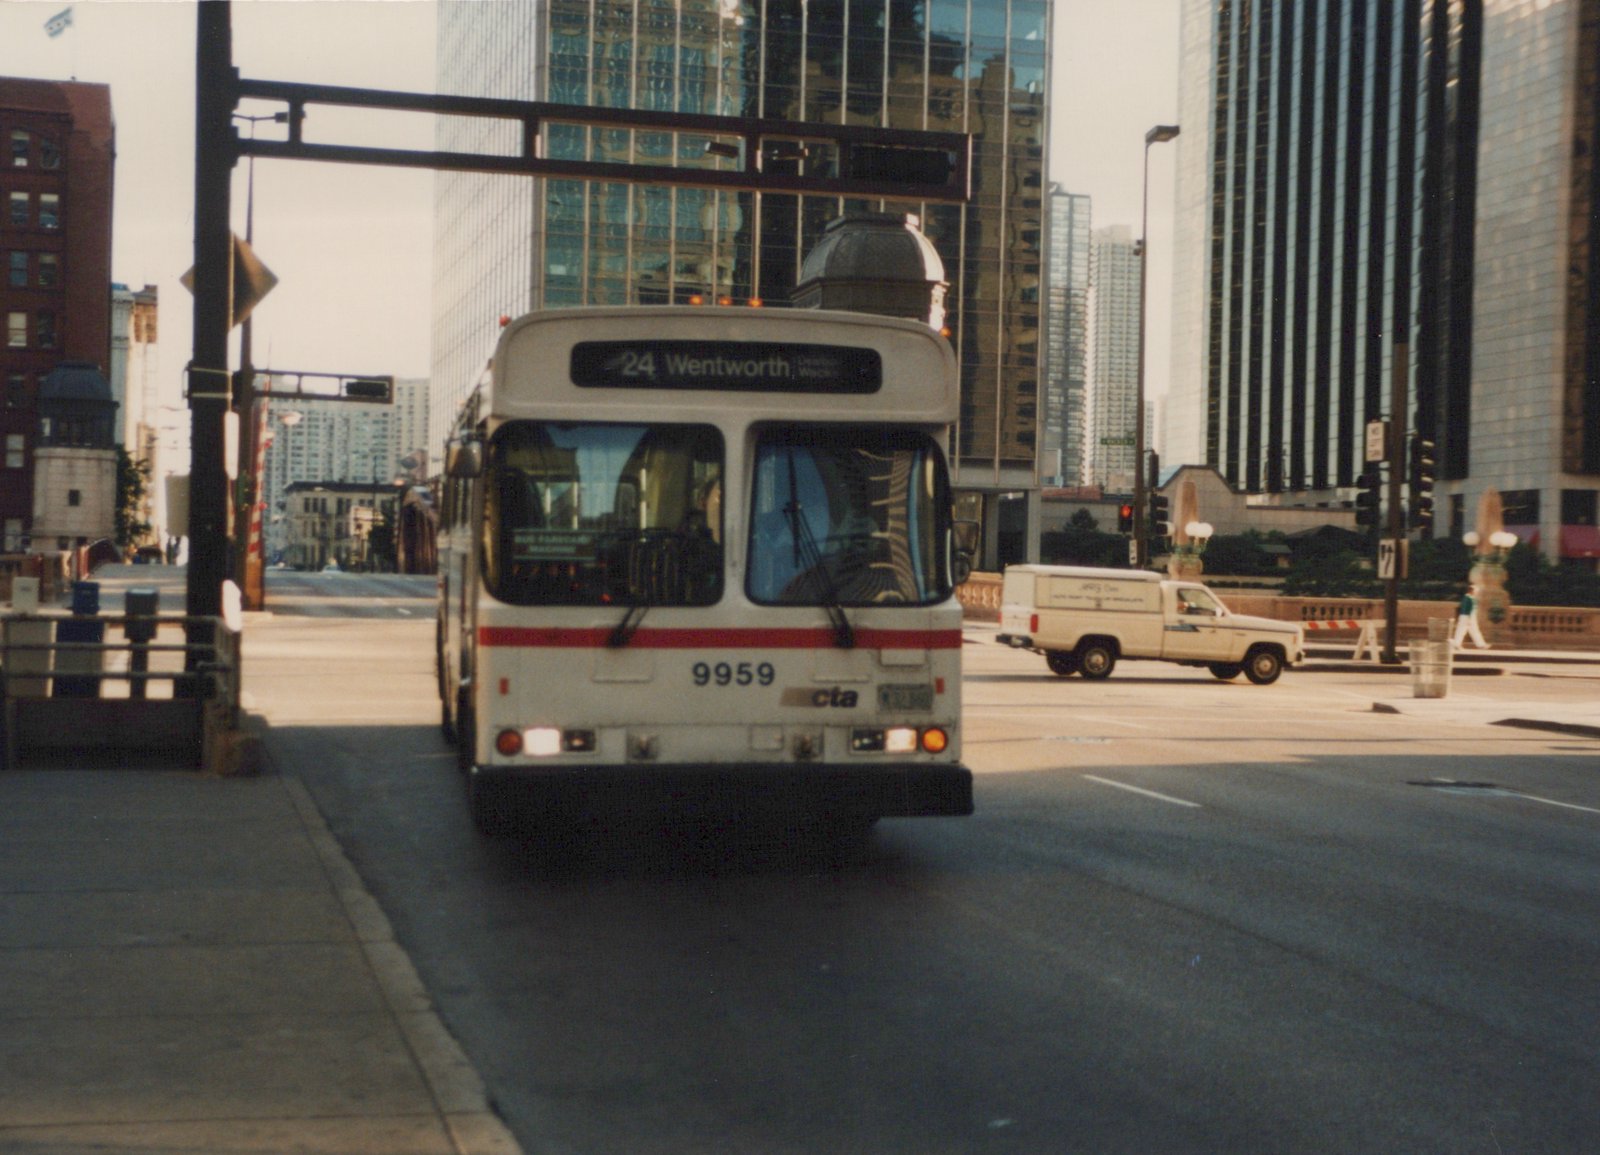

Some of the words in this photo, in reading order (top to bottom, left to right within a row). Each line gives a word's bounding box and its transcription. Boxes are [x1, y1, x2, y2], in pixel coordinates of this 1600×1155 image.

[621, 351, 656, 377] 24
[665, 353, 790, 377] Wentworth
[692, 662, 775, 686] 9959
[811, 687, 859, 709] cta
